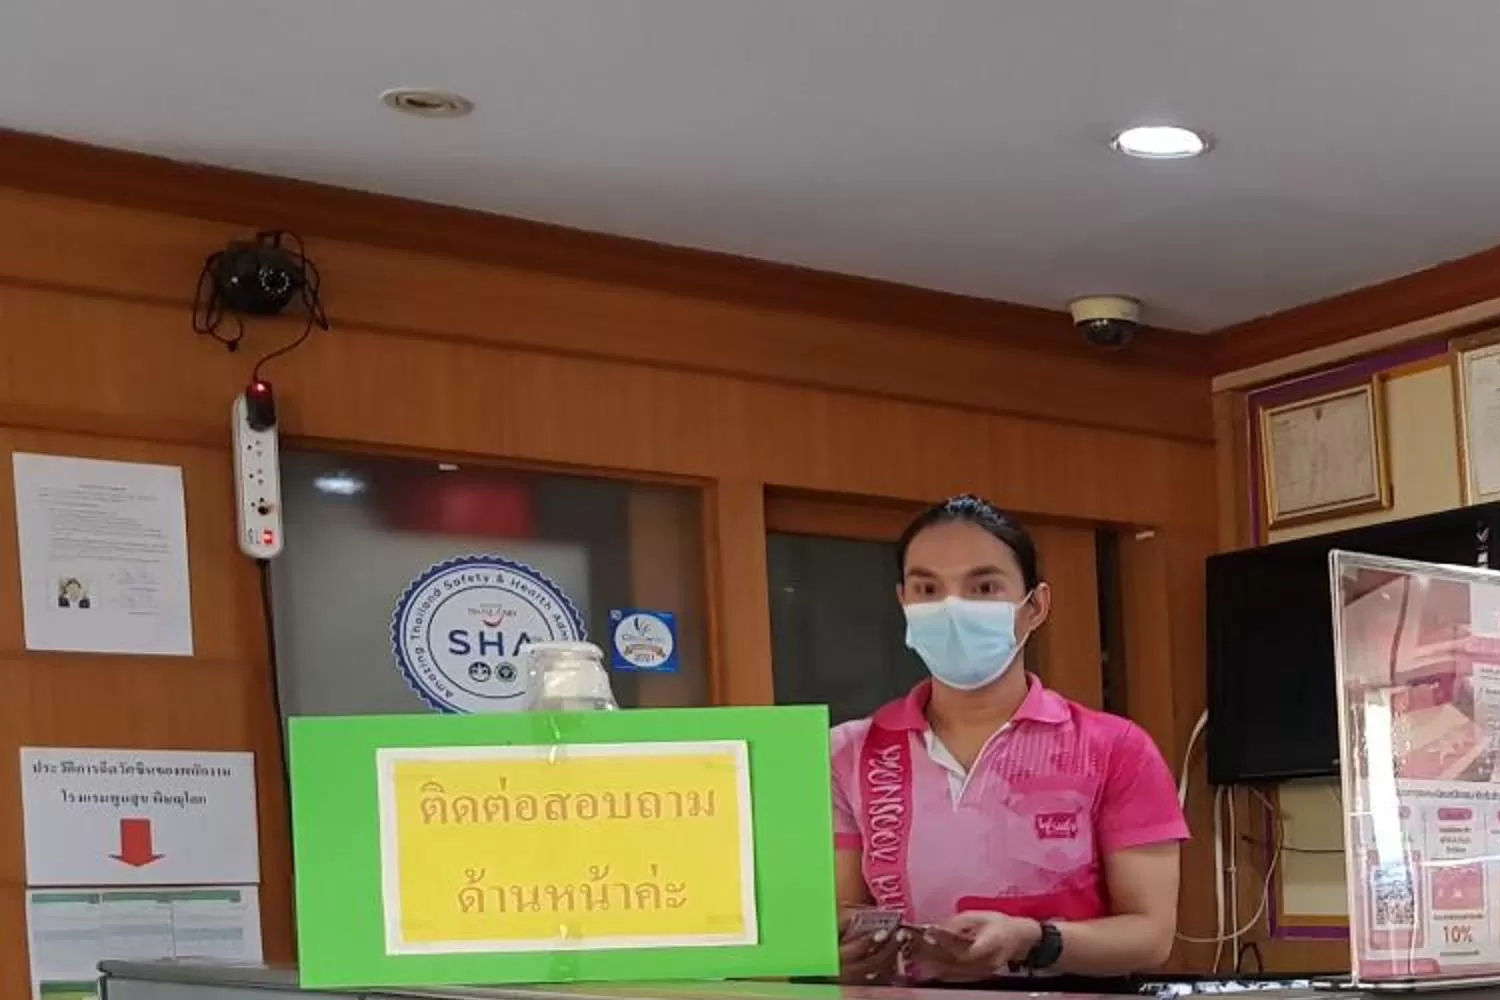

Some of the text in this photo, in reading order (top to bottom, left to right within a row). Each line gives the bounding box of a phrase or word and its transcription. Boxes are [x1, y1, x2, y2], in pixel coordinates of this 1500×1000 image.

[443, 573, 490, 589] Safety
[419, 776, 716, 825] ติดต่อสอบถาม
[456, 863, 688, 914] ด้านหน้าค่ะ
[1442, 924, 1474, 944] 10%
